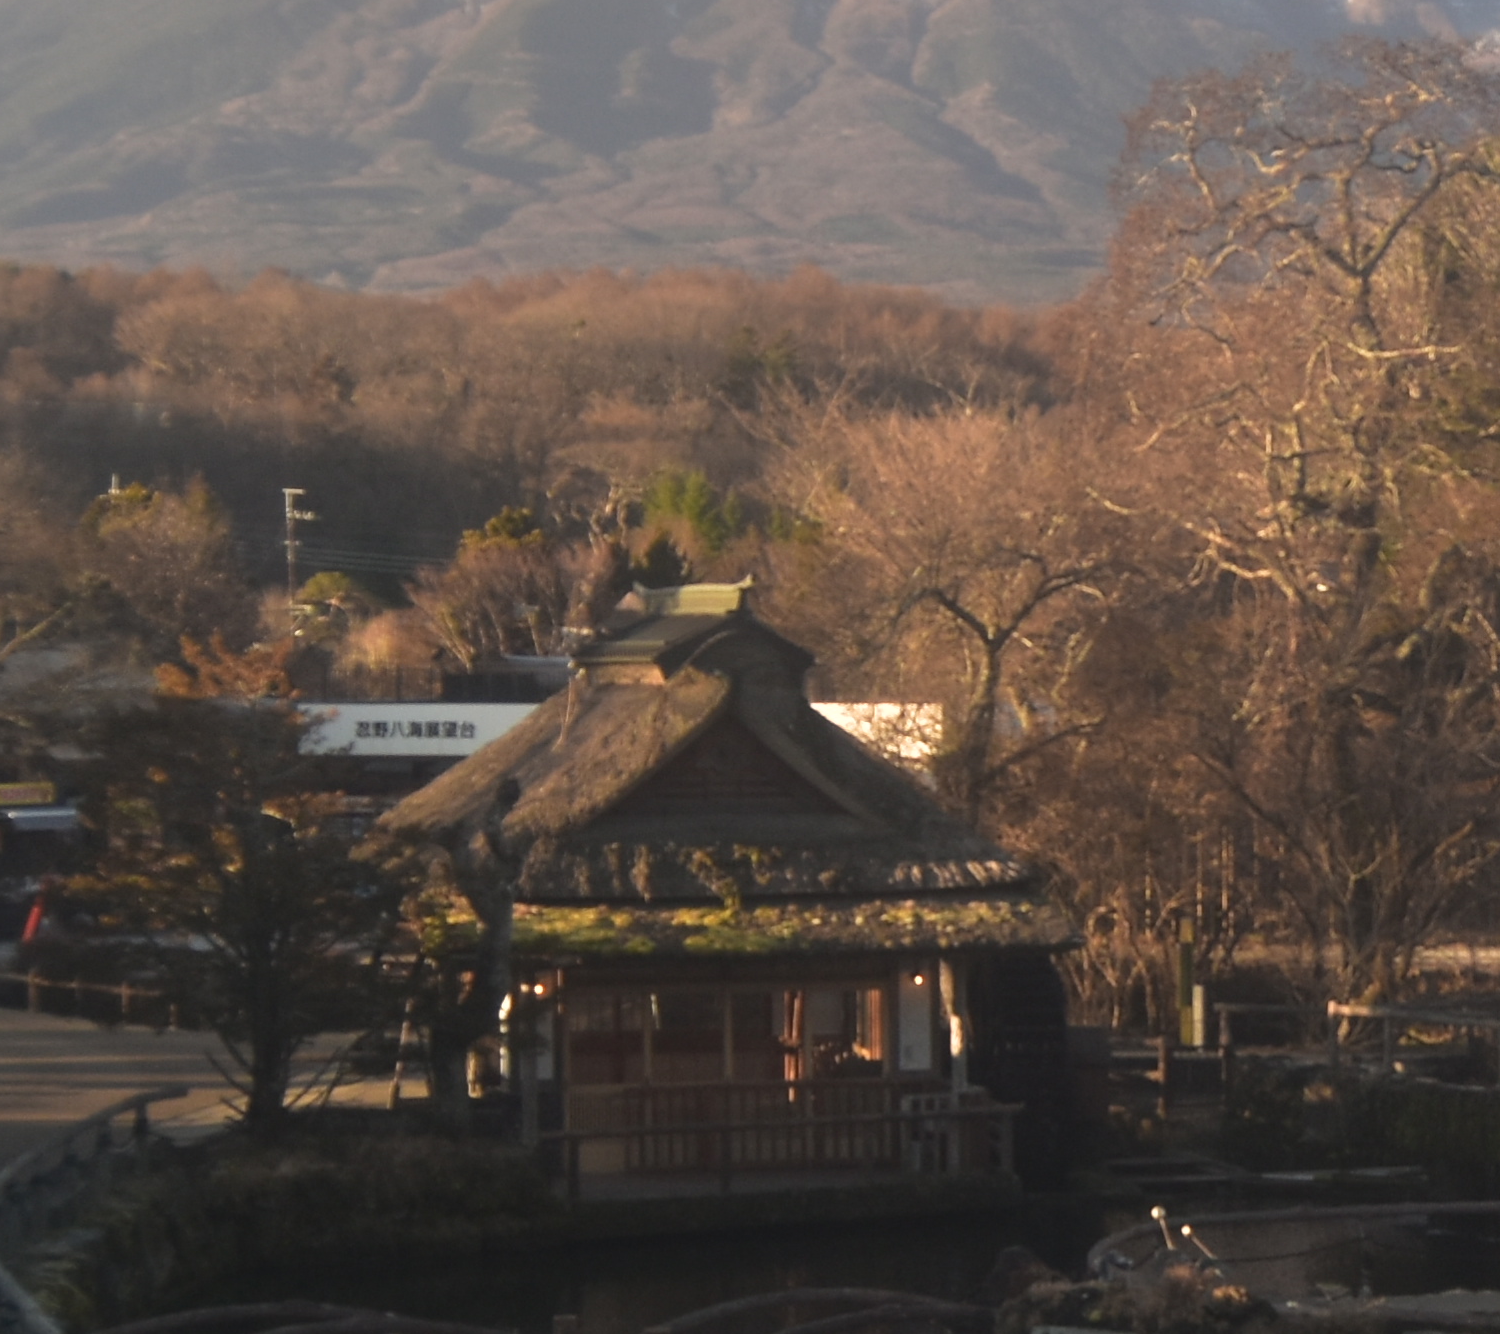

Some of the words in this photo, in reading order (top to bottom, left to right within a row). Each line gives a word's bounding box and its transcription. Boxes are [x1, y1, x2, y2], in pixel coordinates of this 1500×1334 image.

[354, 720, 476, 739] 忍野八海展望台
